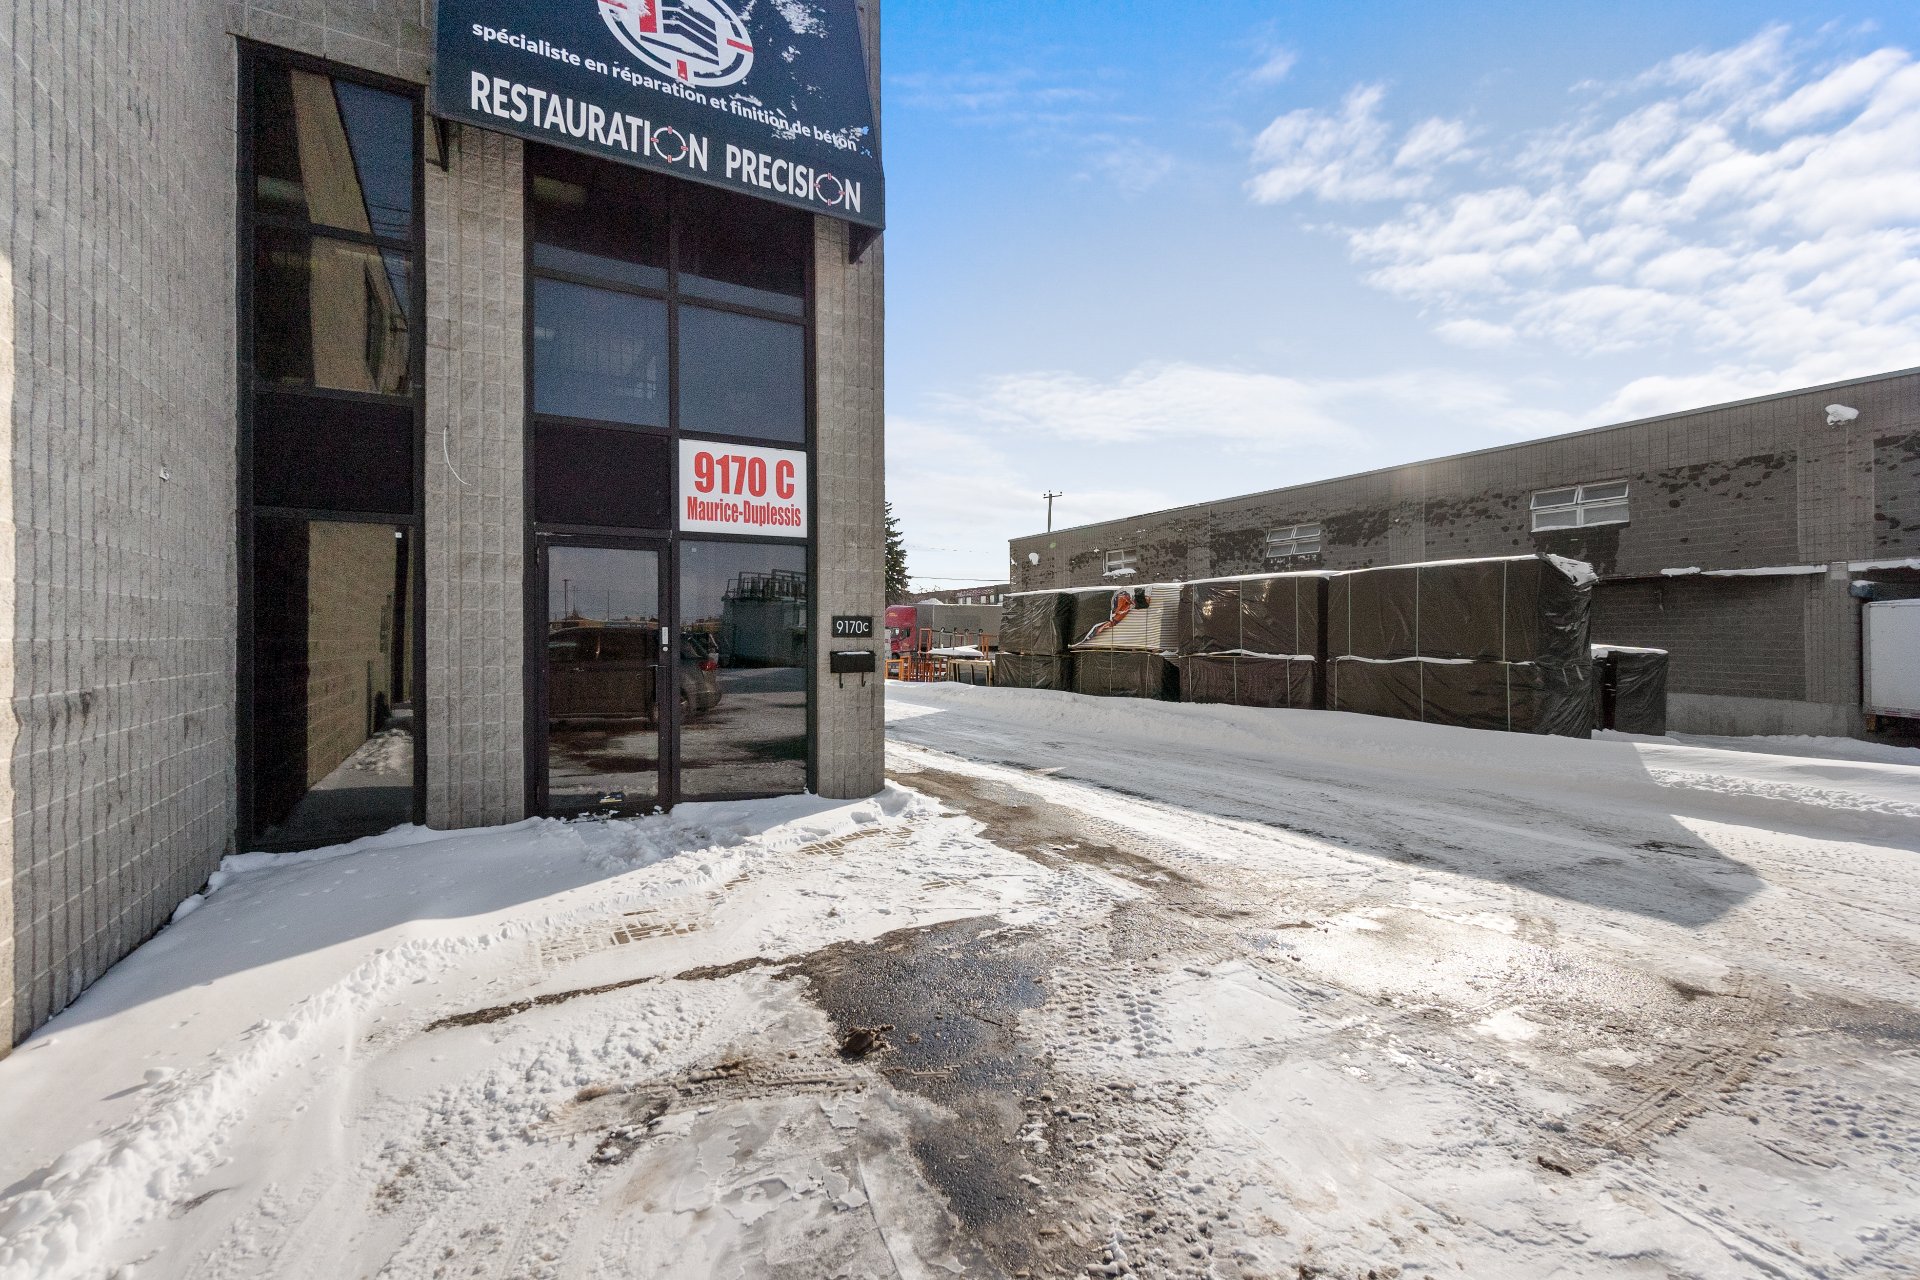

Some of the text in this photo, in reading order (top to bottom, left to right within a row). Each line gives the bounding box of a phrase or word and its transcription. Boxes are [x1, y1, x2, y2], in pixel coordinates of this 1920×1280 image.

[472, 23, 857, 151] spécialiste en réparation et finition de béton
[470, 71, 861, 213] RESTAURATION PRECISION
[687, 496, 802, 528] Maurice-Duplessis
[694, 451, 795, 500] 9170 C
